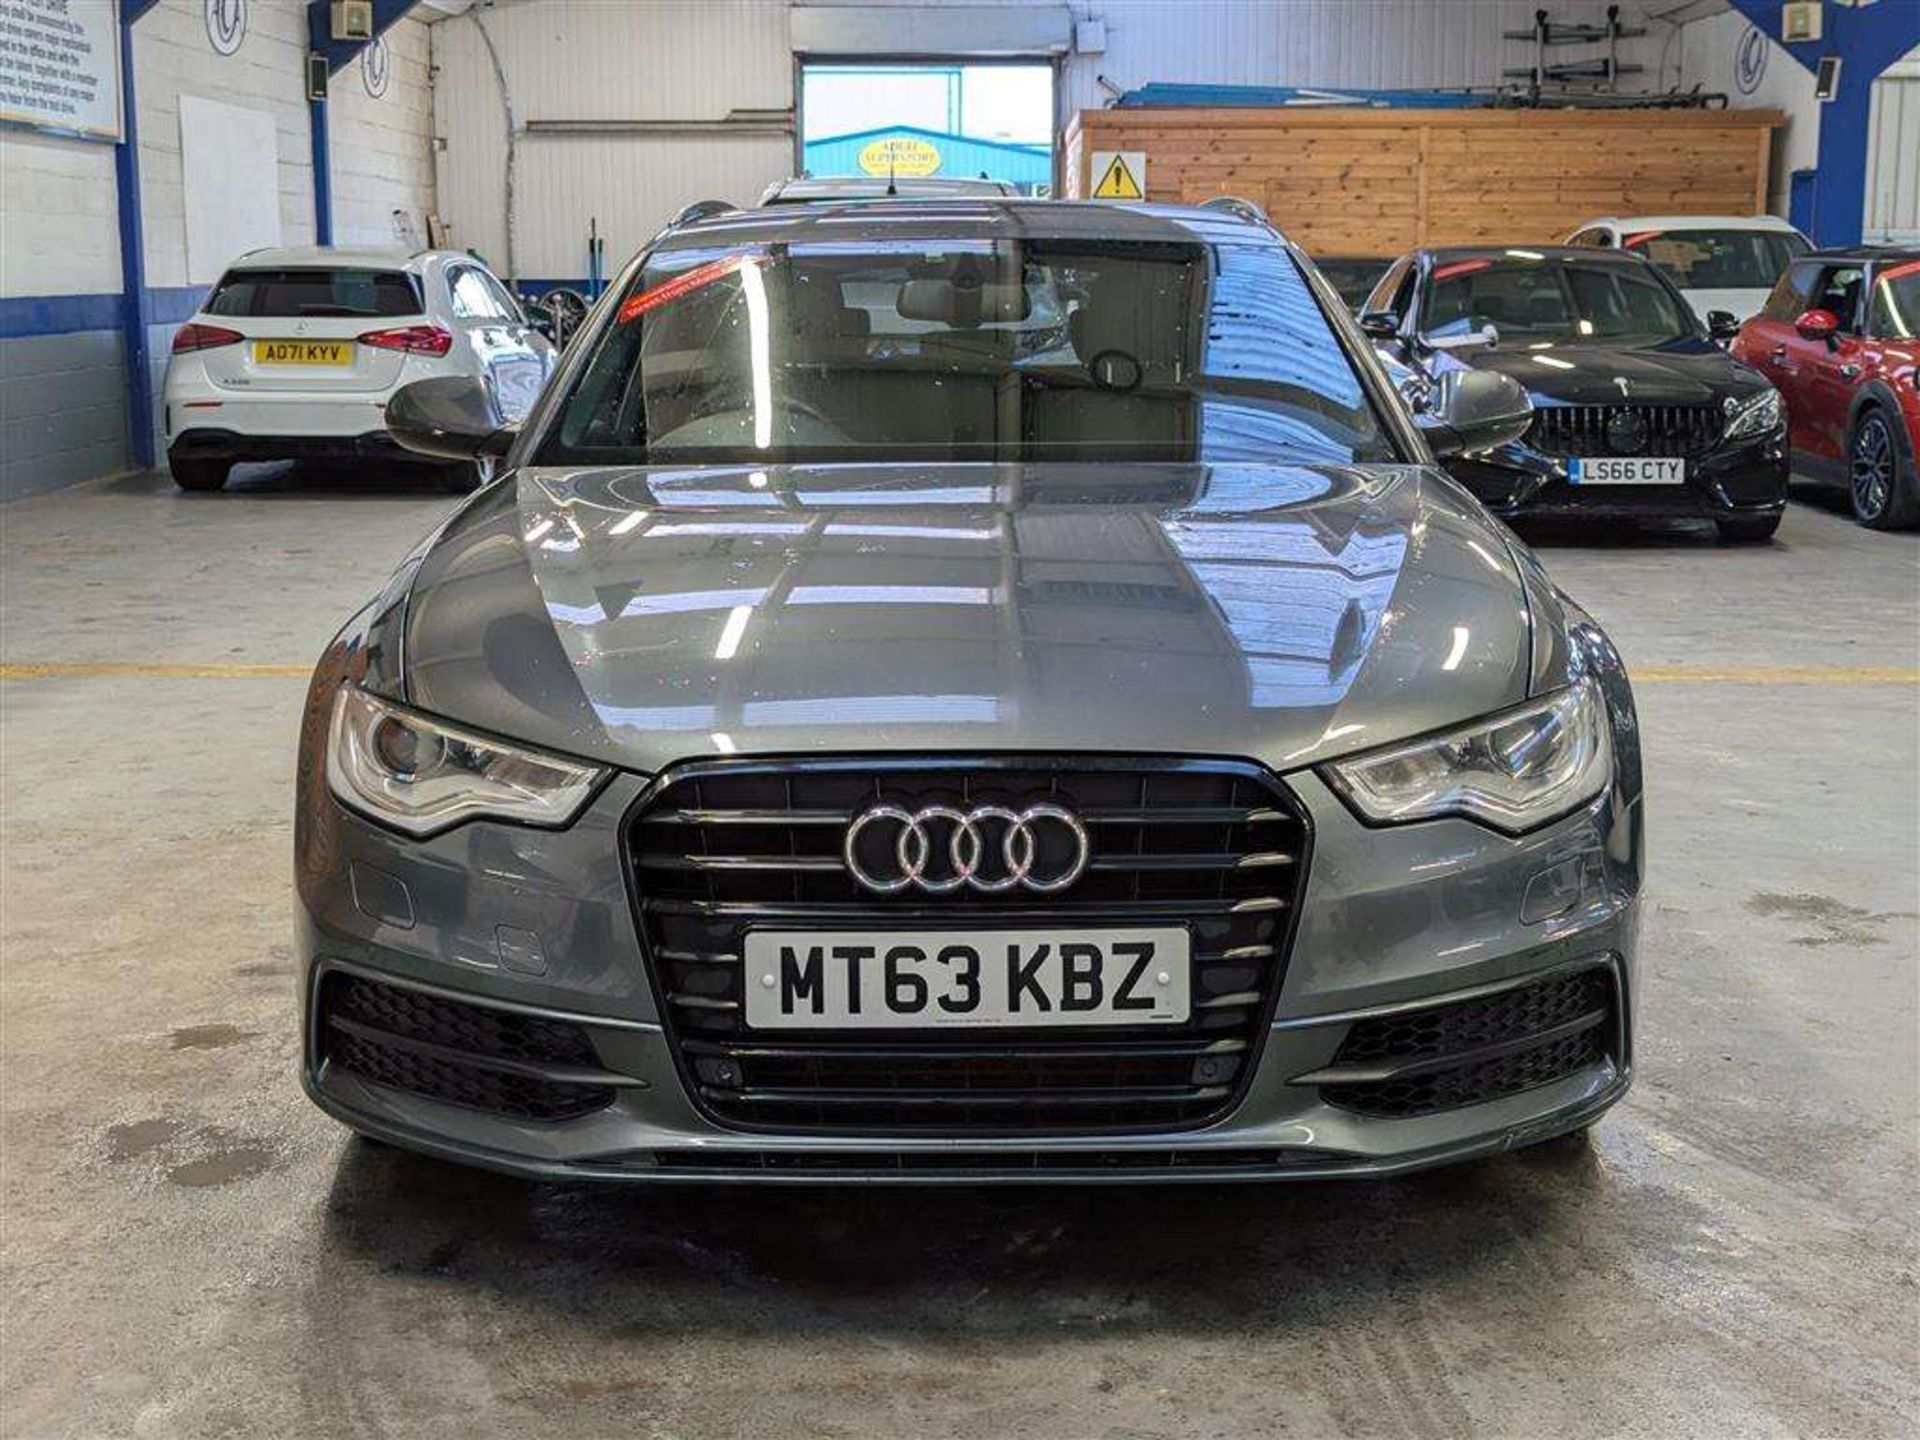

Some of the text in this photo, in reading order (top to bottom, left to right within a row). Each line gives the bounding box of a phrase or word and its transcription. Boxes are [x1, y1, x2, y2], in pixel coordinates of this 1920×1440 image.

[307, 344, 341, 360] KYV
[1584, 462, 1679, 480] LS66 CTY
[780, 942, 1155, 1014] MT63 KBZ
